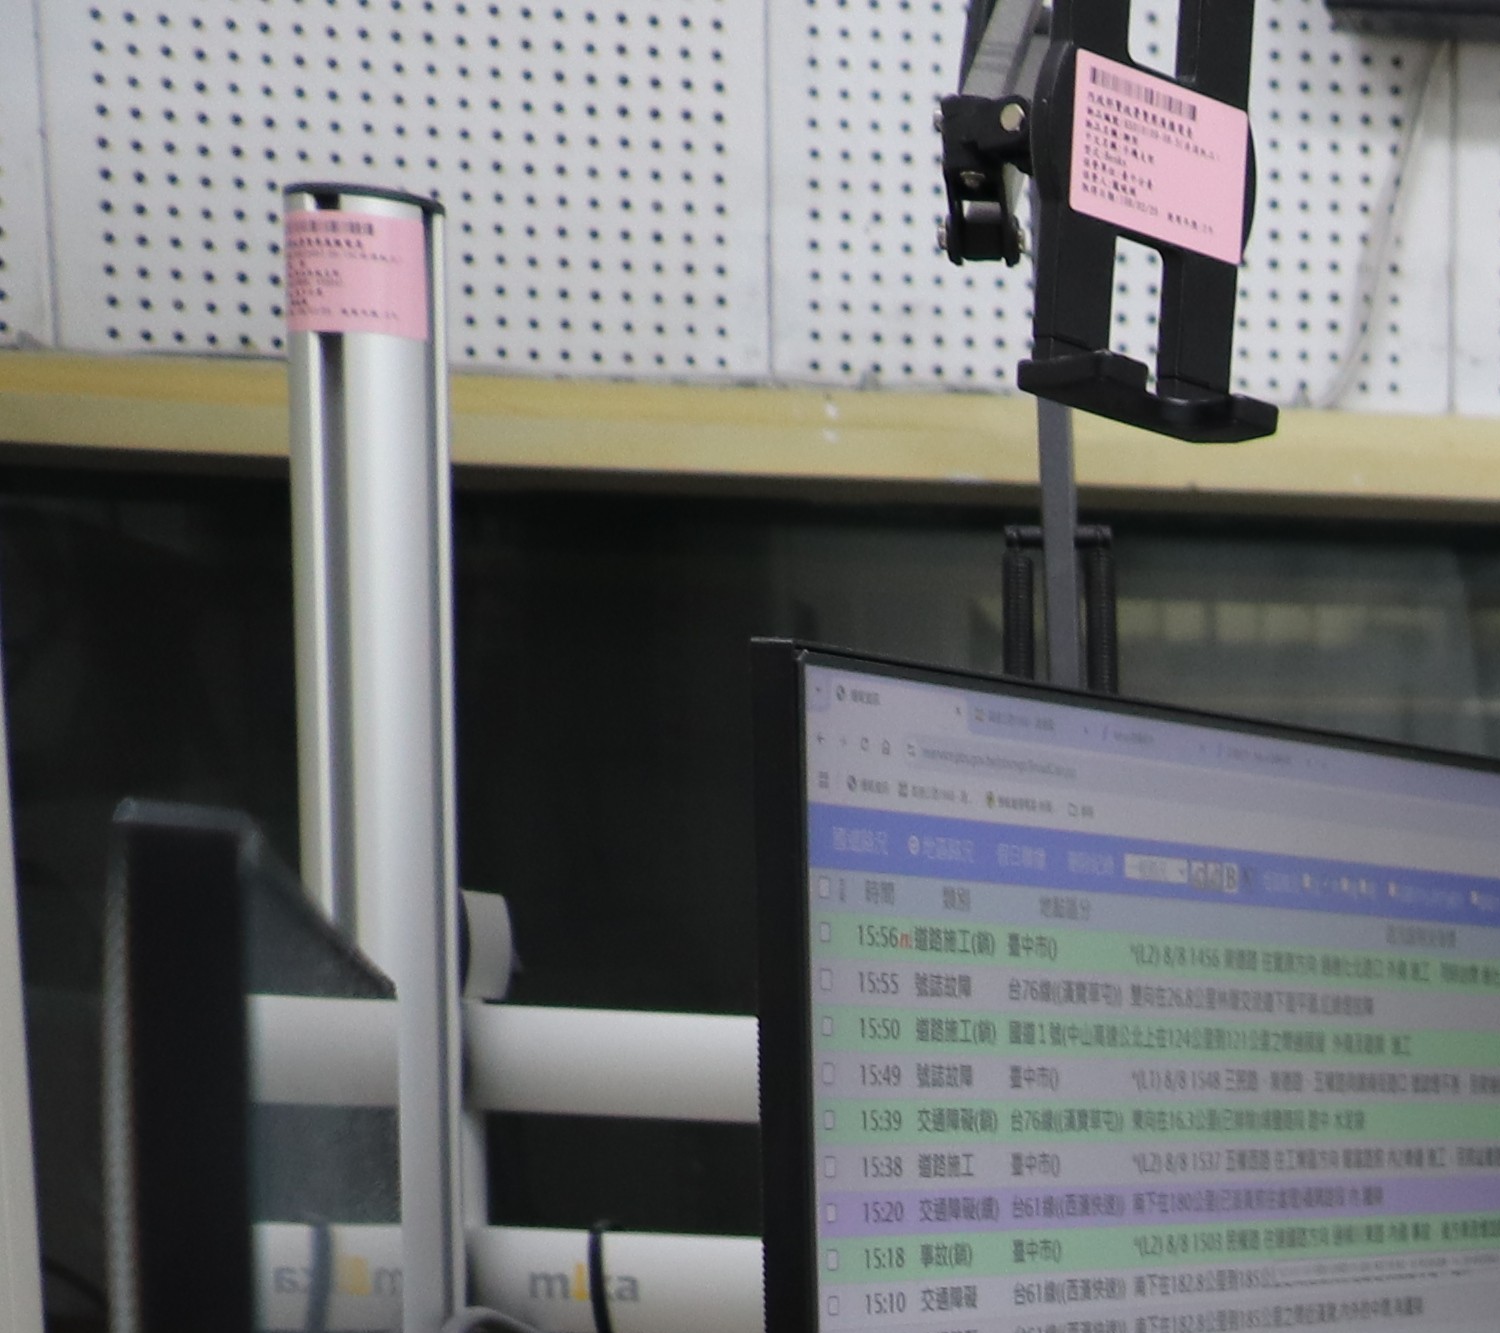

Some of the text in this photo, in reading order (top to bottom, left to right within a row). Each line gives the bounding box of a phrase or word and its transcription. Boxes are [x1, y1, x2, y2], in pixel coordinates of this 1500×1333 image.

[865, 878, 895, 907] 時間
[856, 923, 897, 949] 15:56
[858, 971, 898, 996] 15:55
[859, 1017, 900, 1042] 15:50
[860, 1063, 901, 1086] 15:49
[861, 1109, 902, 1132] 15:39
[862, 1155, 903, 1179] 15:38
[863, 1200, 904, 1224] 15:20
[864, 1245, 905, 1270] 15:18
[865, 1290, 906, 1316] 15:10
